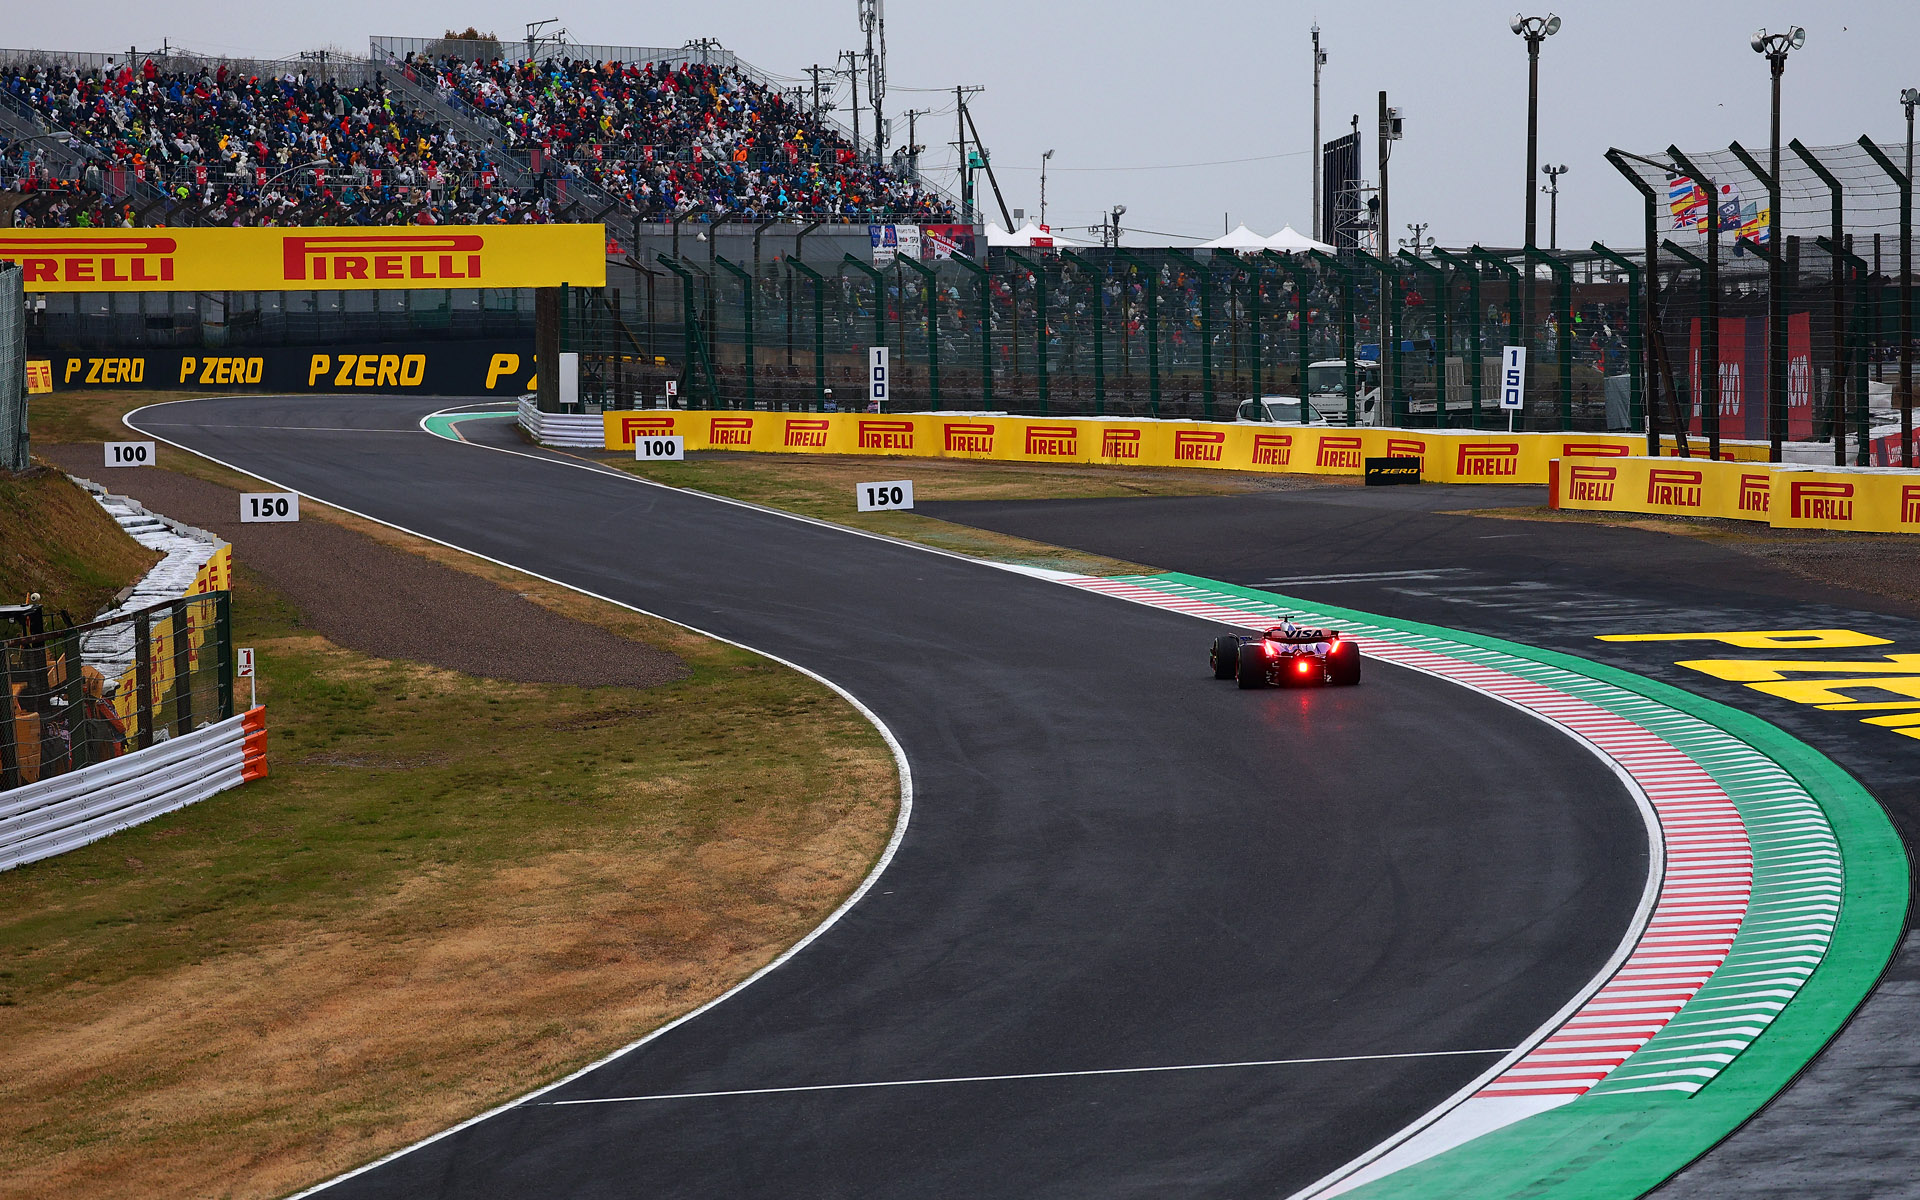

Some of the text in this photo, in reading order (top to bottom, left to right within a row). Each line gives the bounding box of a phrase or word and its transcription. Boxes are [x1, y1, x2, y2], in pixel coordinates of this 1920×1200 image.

[0, 238, 177, 282] RELLI
[283, 235, 484, 280] PIRELLI
[64, 358, 82, 384] P
[85, 358, 145, 383] ZERO
[179, 357, 264, 384] P ZERO
[308, 354, 426, 387] P ZERO
[485, 353, 520, 389] P
[873, 350, 883, 398] 100
[1507, 350, 1519, 405] 150
[710, 418, 754, 445] PIRELLI
[785, 420, 830, 446] PIRELLI
[858, 421, 914, 450] PIRELLI
[944, 424, 995, 452] PIRELLI
[1025, 426, 1077, 456] PIRELLI
[1101, 429, 1141, 458] PIRELLI
[1175, 431, 1226, 461] PIRELLI
[113, 445, 147, 463] 100
[644, 440, 676, 456] 100
[1252, 435, 1293, 465] PIRELLI
[1316, 437, 1362, 468] PIRELLI
[1457, 443, 1519, 475] PIRELLI
[866, 486, 903, 507] 150
[1569, 466, 1617, 502] PIRELLI
[1738, 474, 1770, 512] PIRE
[250, 498, 288, 518] 150
[1790, 482, 1854, 520] PIRELLI
[1285, 629, 1324, 638] VISA
